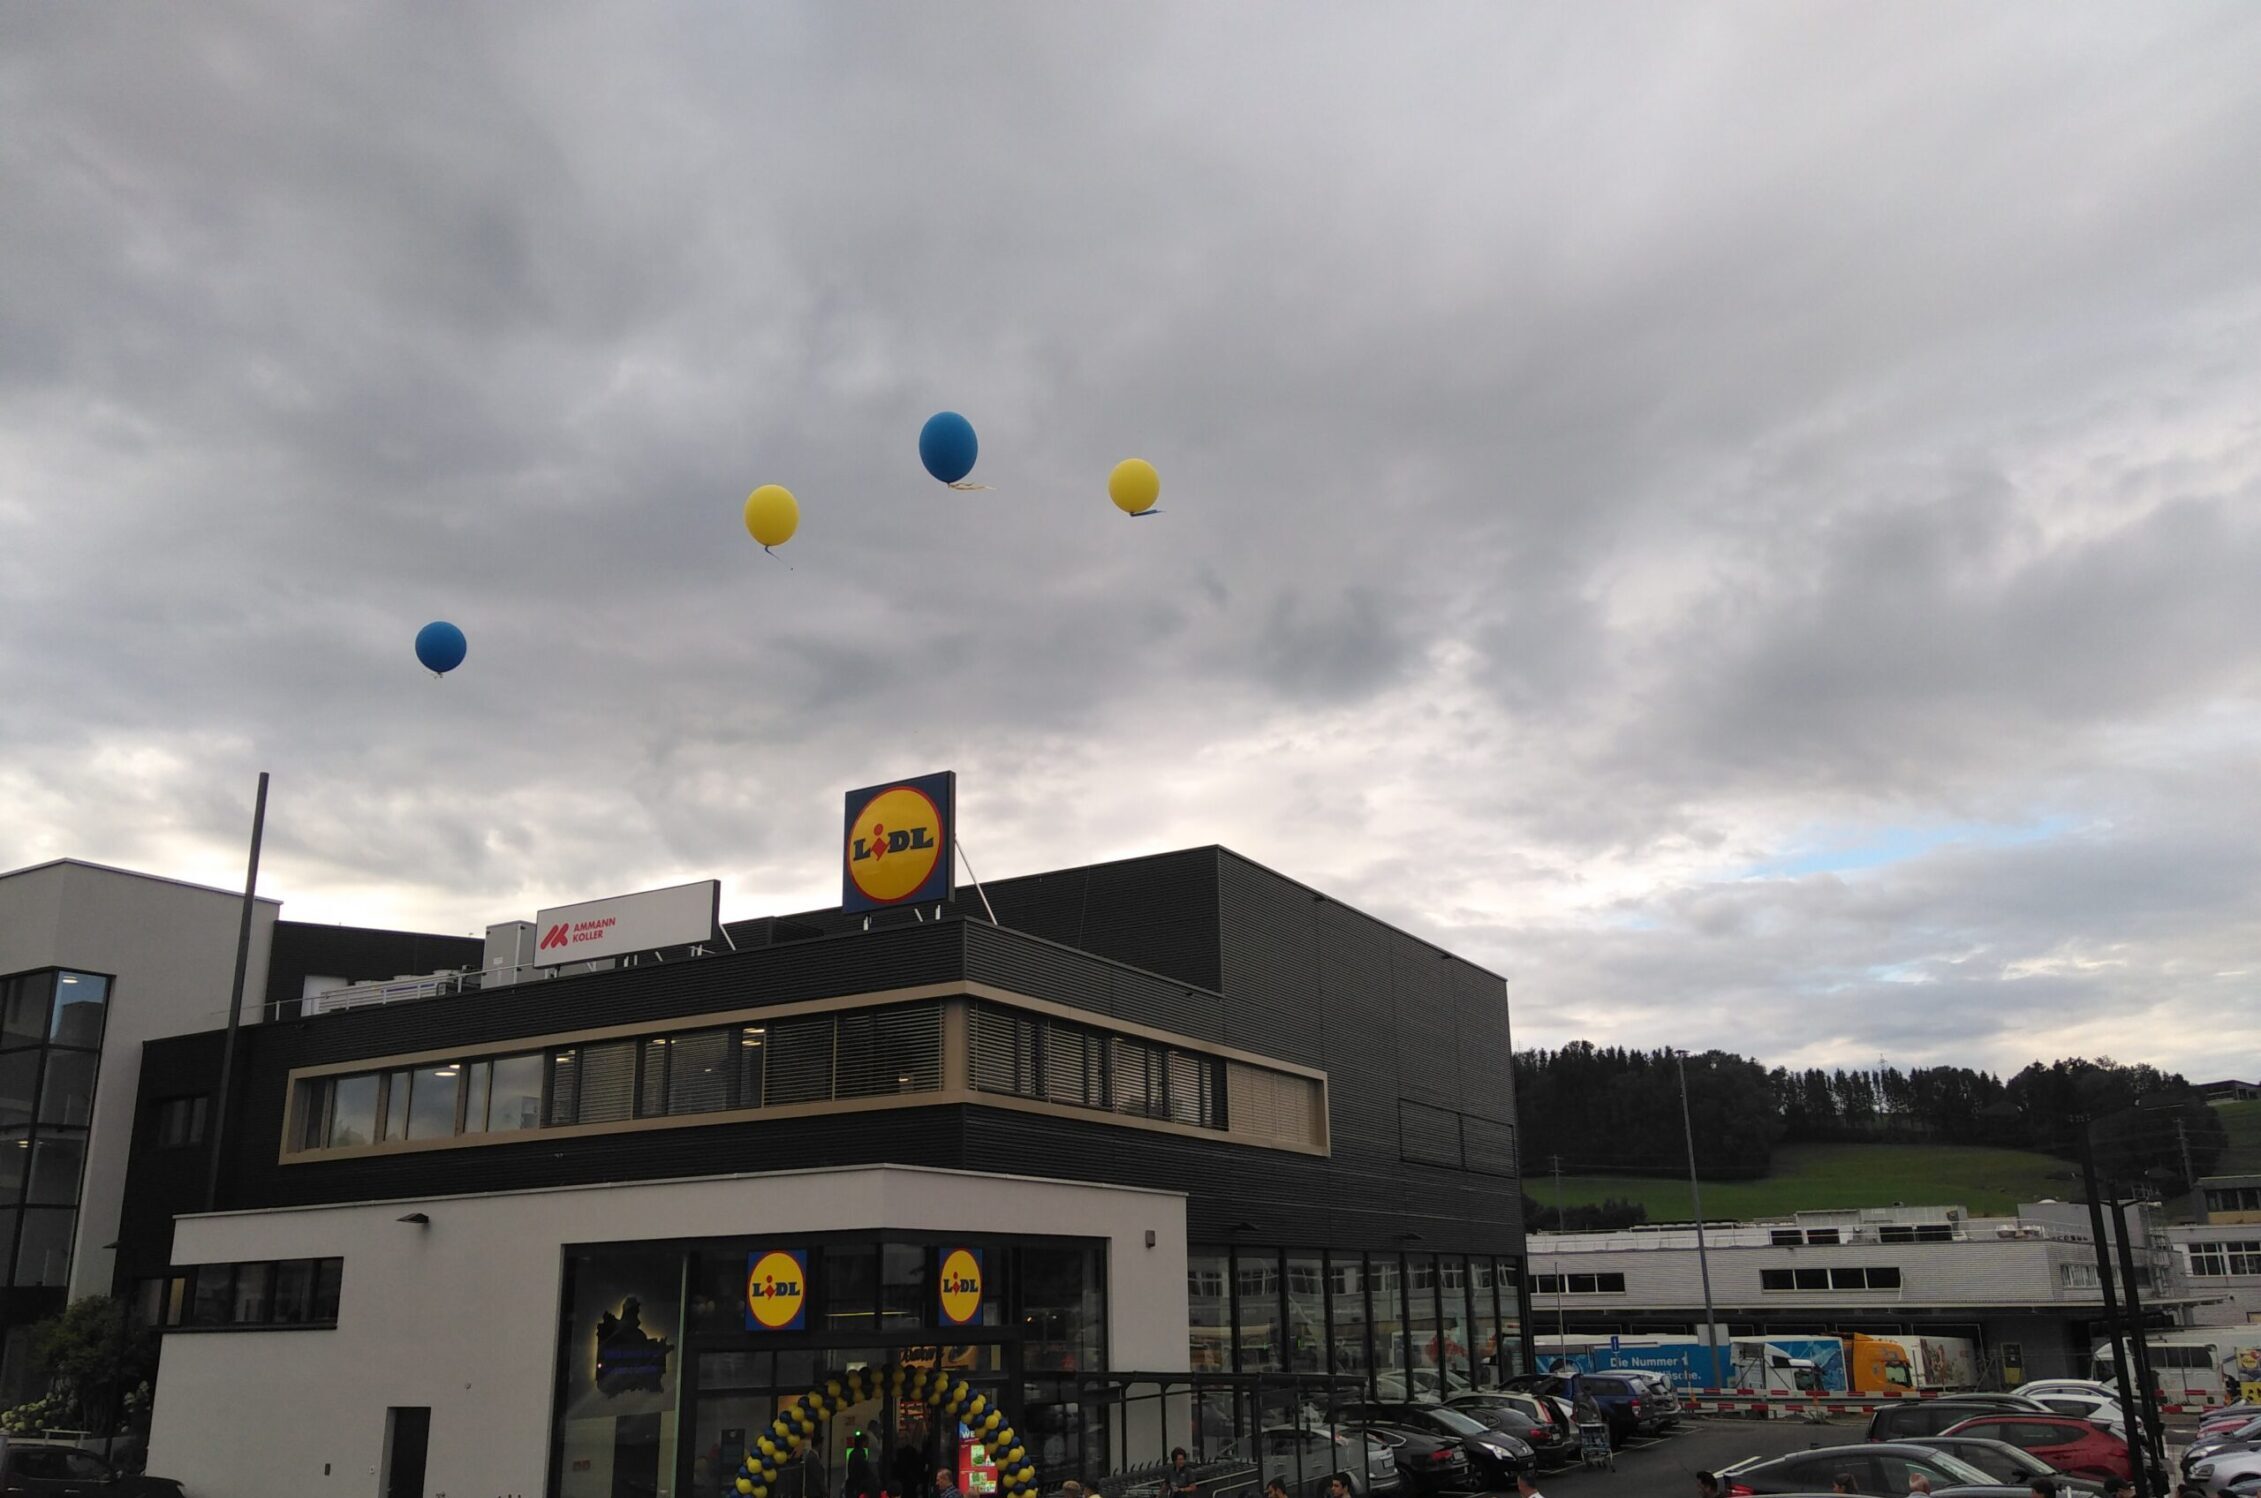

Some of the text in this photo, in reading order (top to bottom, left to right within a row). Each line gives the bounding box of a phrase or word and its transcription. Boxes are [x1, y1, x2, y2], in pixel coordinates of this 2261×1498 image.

[573, 917, 616, 933] AMMANN
[572, 930, 604, 943] KOLLER
[1610, 1357, 1629, 1368] Die
[1631, 1356, 1678, 1367] Nummer
